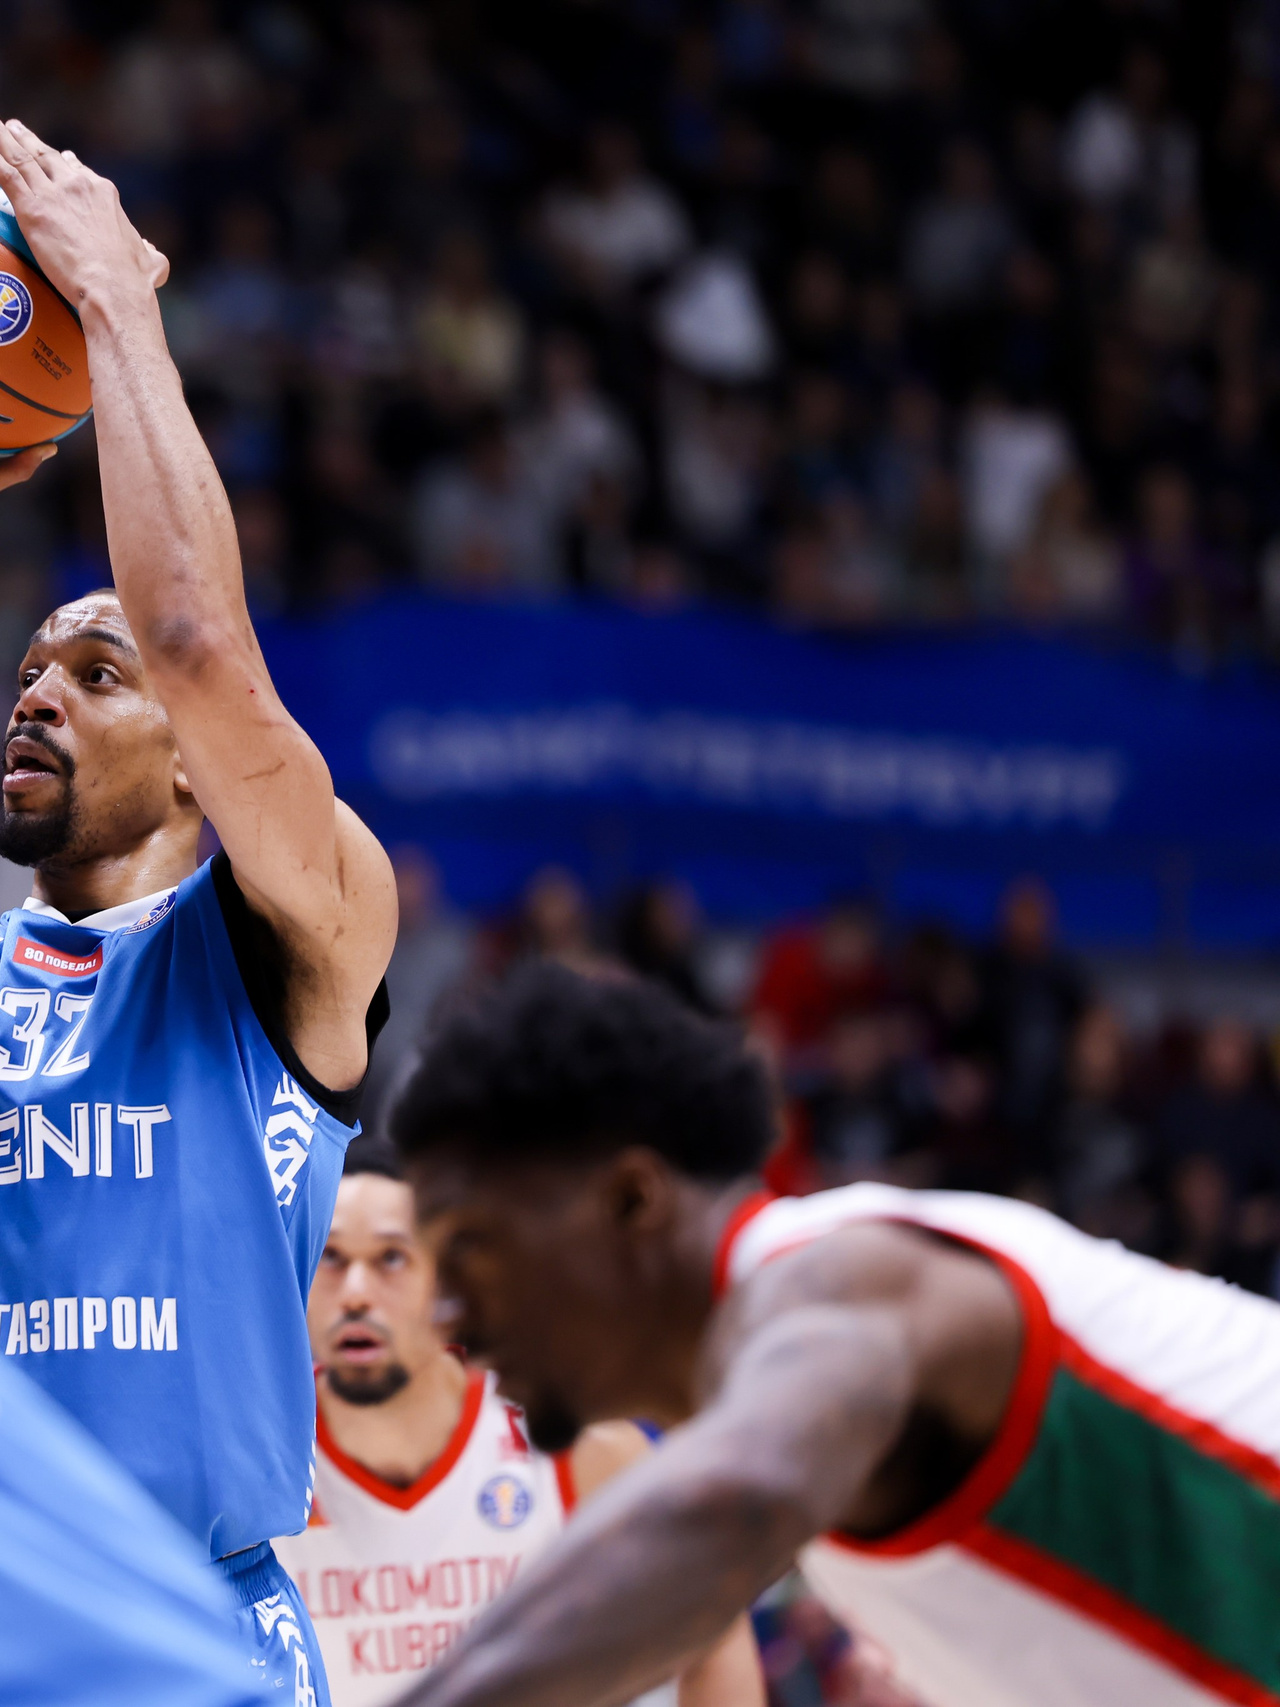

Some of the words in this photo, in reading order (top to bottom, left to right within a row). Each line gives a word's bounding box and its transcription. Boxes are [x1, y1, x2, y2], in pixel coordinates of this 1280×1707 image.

[35, 336, 54, 357] BALL
[31, 347, 62, 381] OFFICIAL
[52, 354, 72, 376] GAME
[24, 947, 43, 962] 80
[45, 955, 97, 972] ПОБЕДА!
